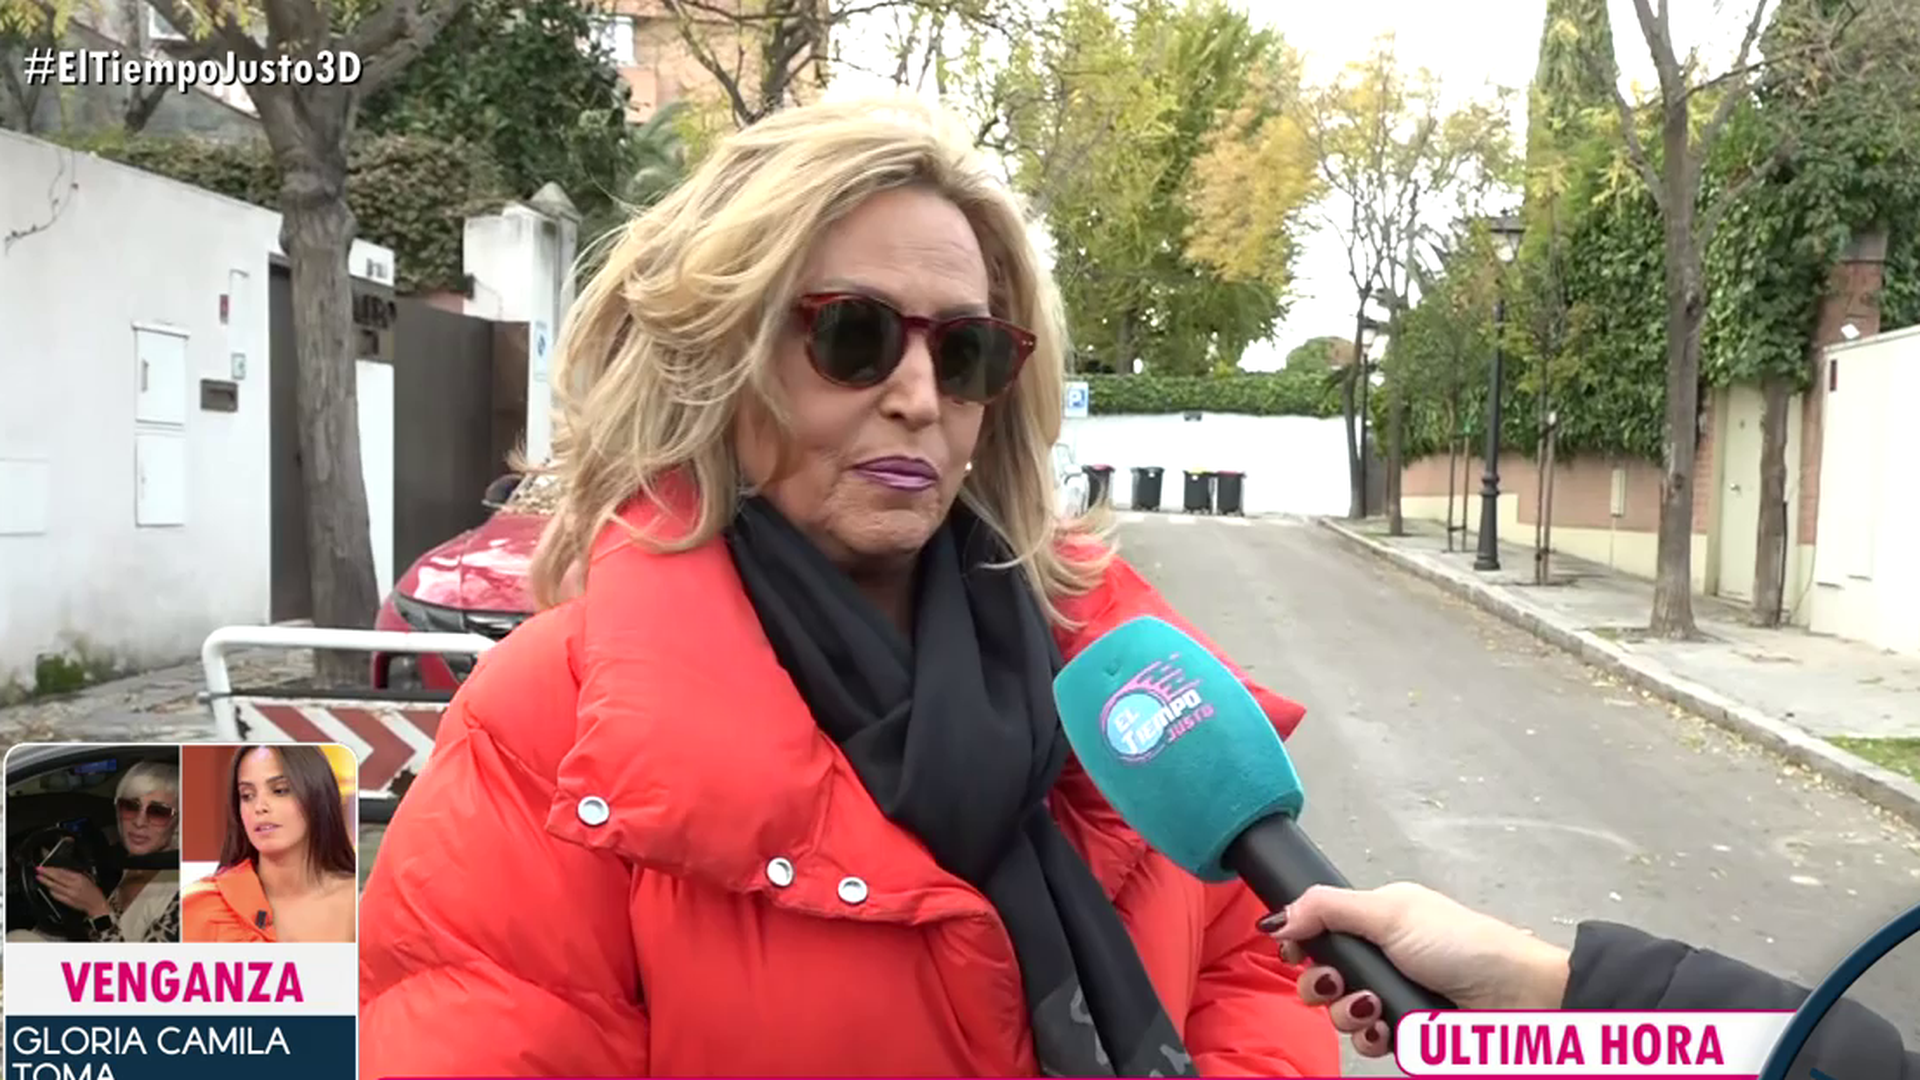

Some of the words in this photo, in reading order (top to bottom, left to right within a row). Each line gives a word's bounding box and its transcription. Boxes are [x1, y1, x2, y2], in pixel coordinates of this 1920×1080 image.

[1115, 709, 1139, 733] EL
[1121, 688, 1202, 755] TIEMPO
[1167, 703, 1215, 743] JUSTO
